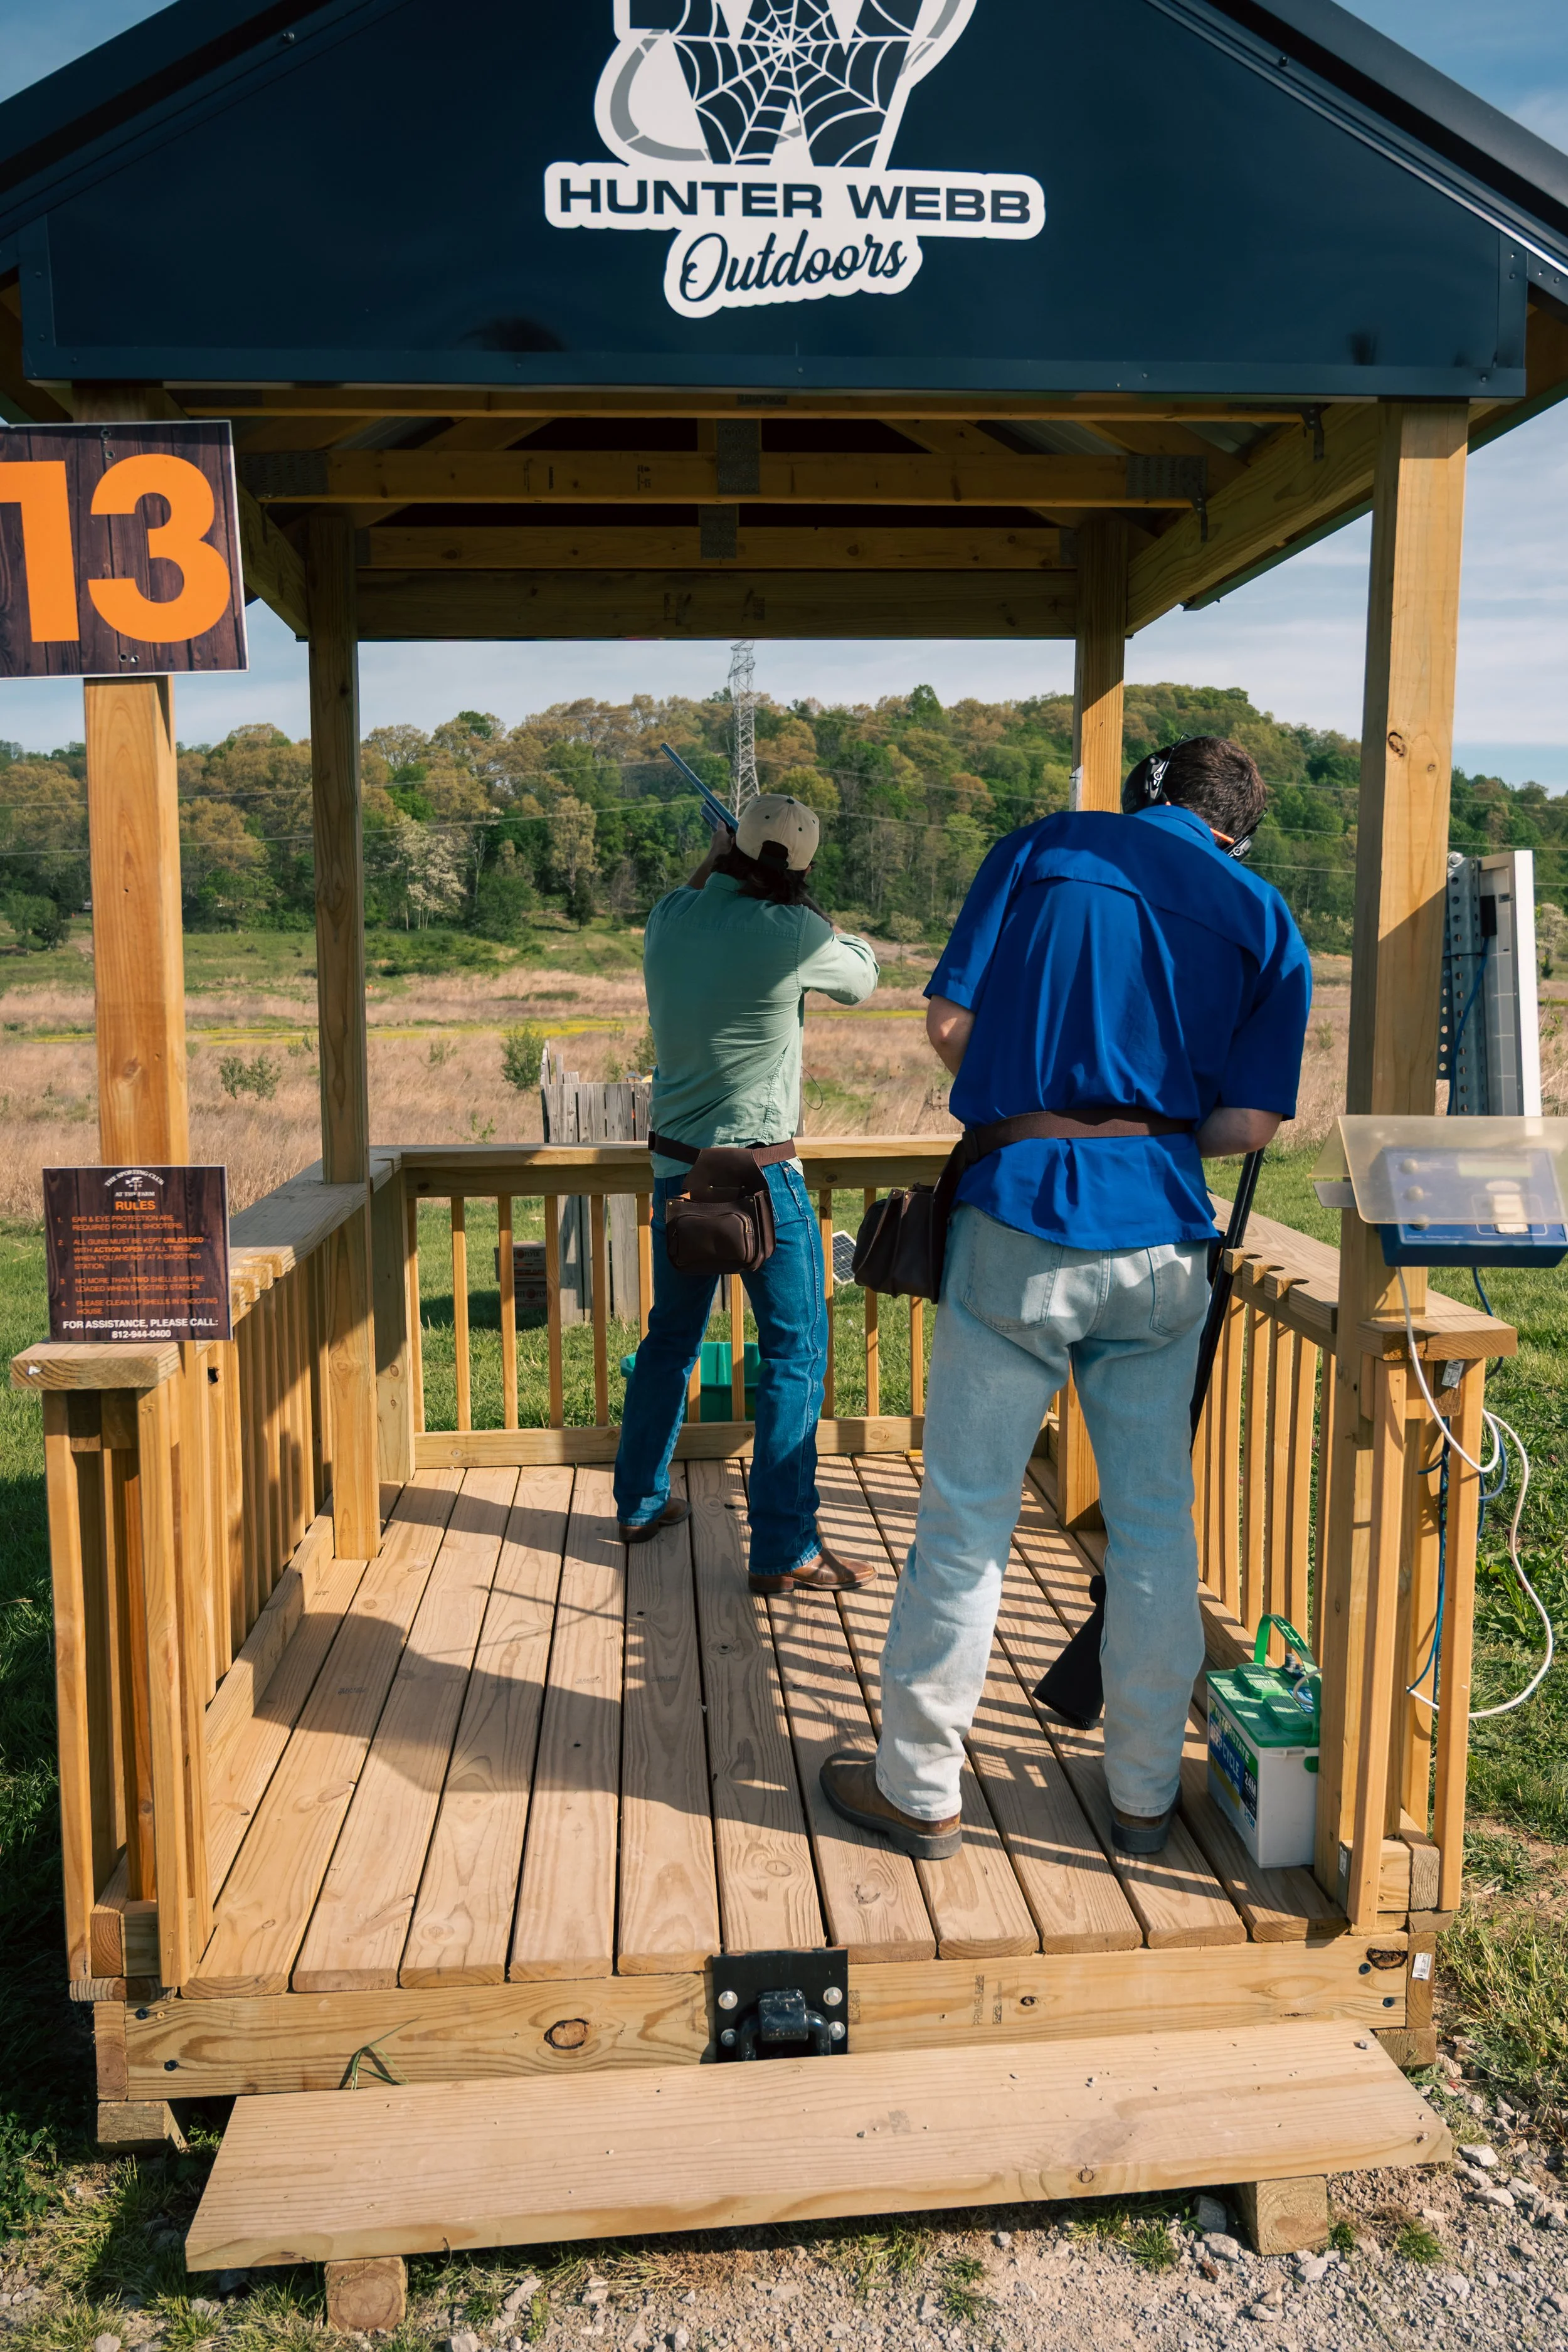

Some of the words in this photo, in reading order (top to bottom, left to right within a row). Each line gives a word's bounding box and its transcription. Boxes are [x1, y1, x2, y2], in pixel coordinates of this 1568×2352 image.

[559, 178, 823, 219] HUNTER
[846, 185, 1031, 224] WEBB
[679, 229, 908, 303] Outdoors
[0, 453, 231, 644] 13
[104, 1175, 118, 1187] THE
[116, 1169, 149, 1179] SPORTING
[148, 1173, 165, 1185] CLUB
[115, 1200, 156, 1210] RULES
[63, 1320, 84, 1329] FOR
[85, 1319, 148, 1329] ASSISTANCE,
[150, 1318, 188, 1327] PLEASE
[189, 1318, 219, 1327] CALL:
[112, 1330, 172, 1339] 812-944-0400
[1214, 1707, 1250, 1764] INTERSTATE
[1222, 1742, 1239, 1779] CYCLE
[1244, 1771, 1256, 1799] 24M
[973, 1999, 983, 2025] PRIME
